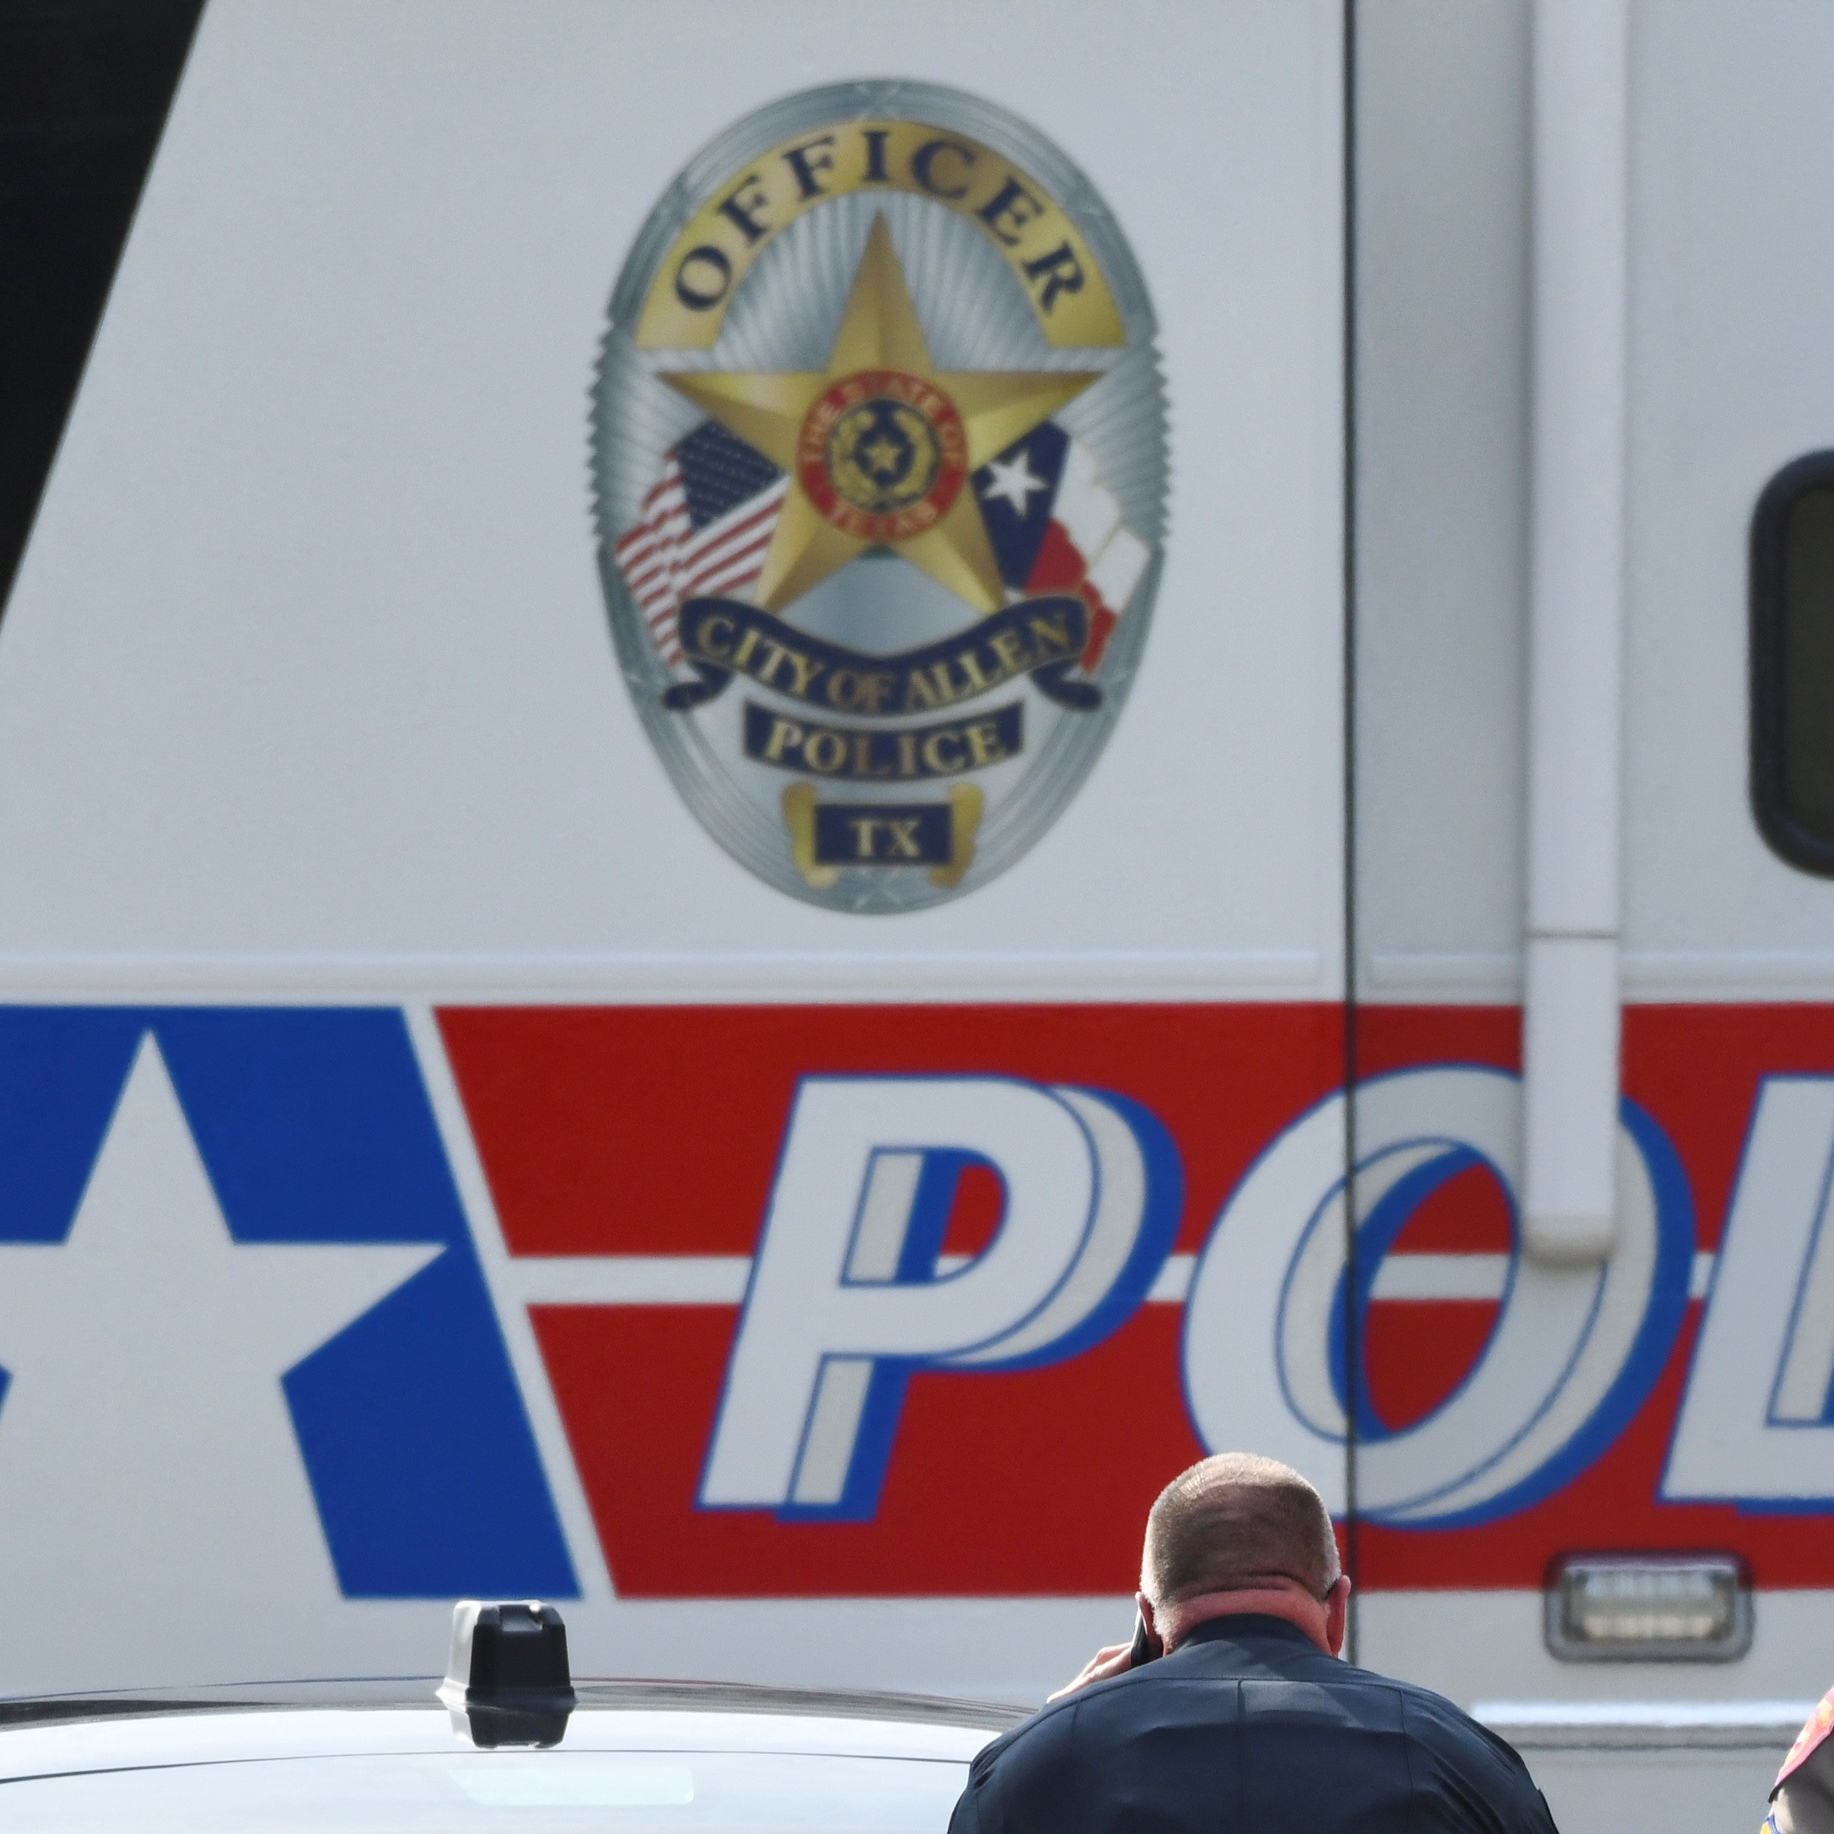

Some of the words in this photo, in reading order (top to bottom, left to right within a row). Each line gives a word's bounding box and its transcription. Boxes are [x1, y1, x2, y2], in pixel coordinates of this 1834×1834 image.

[673, 129, 1086, 315] OFFICER
[696, 613, 825, 697] CITY
[826, 669, 896, 711] OF
[905, 611, 1068, 711] ALLEN
[767, 718, 1007, 777] POLICE
[849, 819, 922, 857] TX
